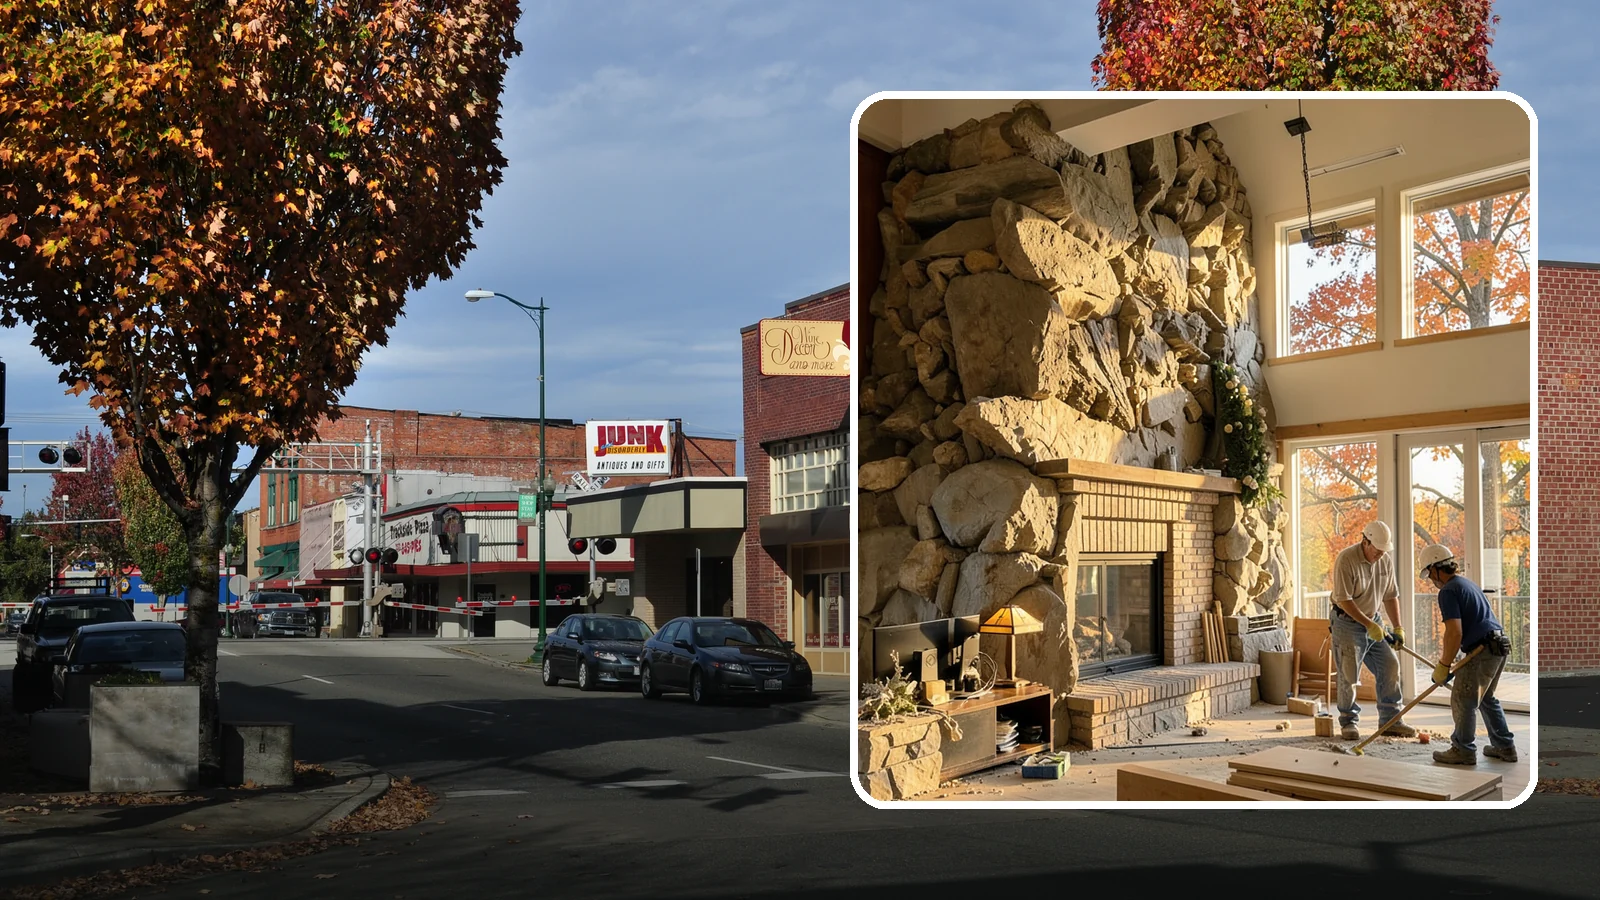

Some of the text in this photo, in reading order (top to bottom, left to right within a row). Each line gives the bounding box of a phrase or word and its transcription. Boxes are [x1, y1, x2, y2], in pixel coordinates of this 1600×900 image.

[596, 425, 665, 457] JUNK
[597, 460, 665, 470] ANTIQUES AND GIFTS
[414, 519, 429, 535] Pizza
